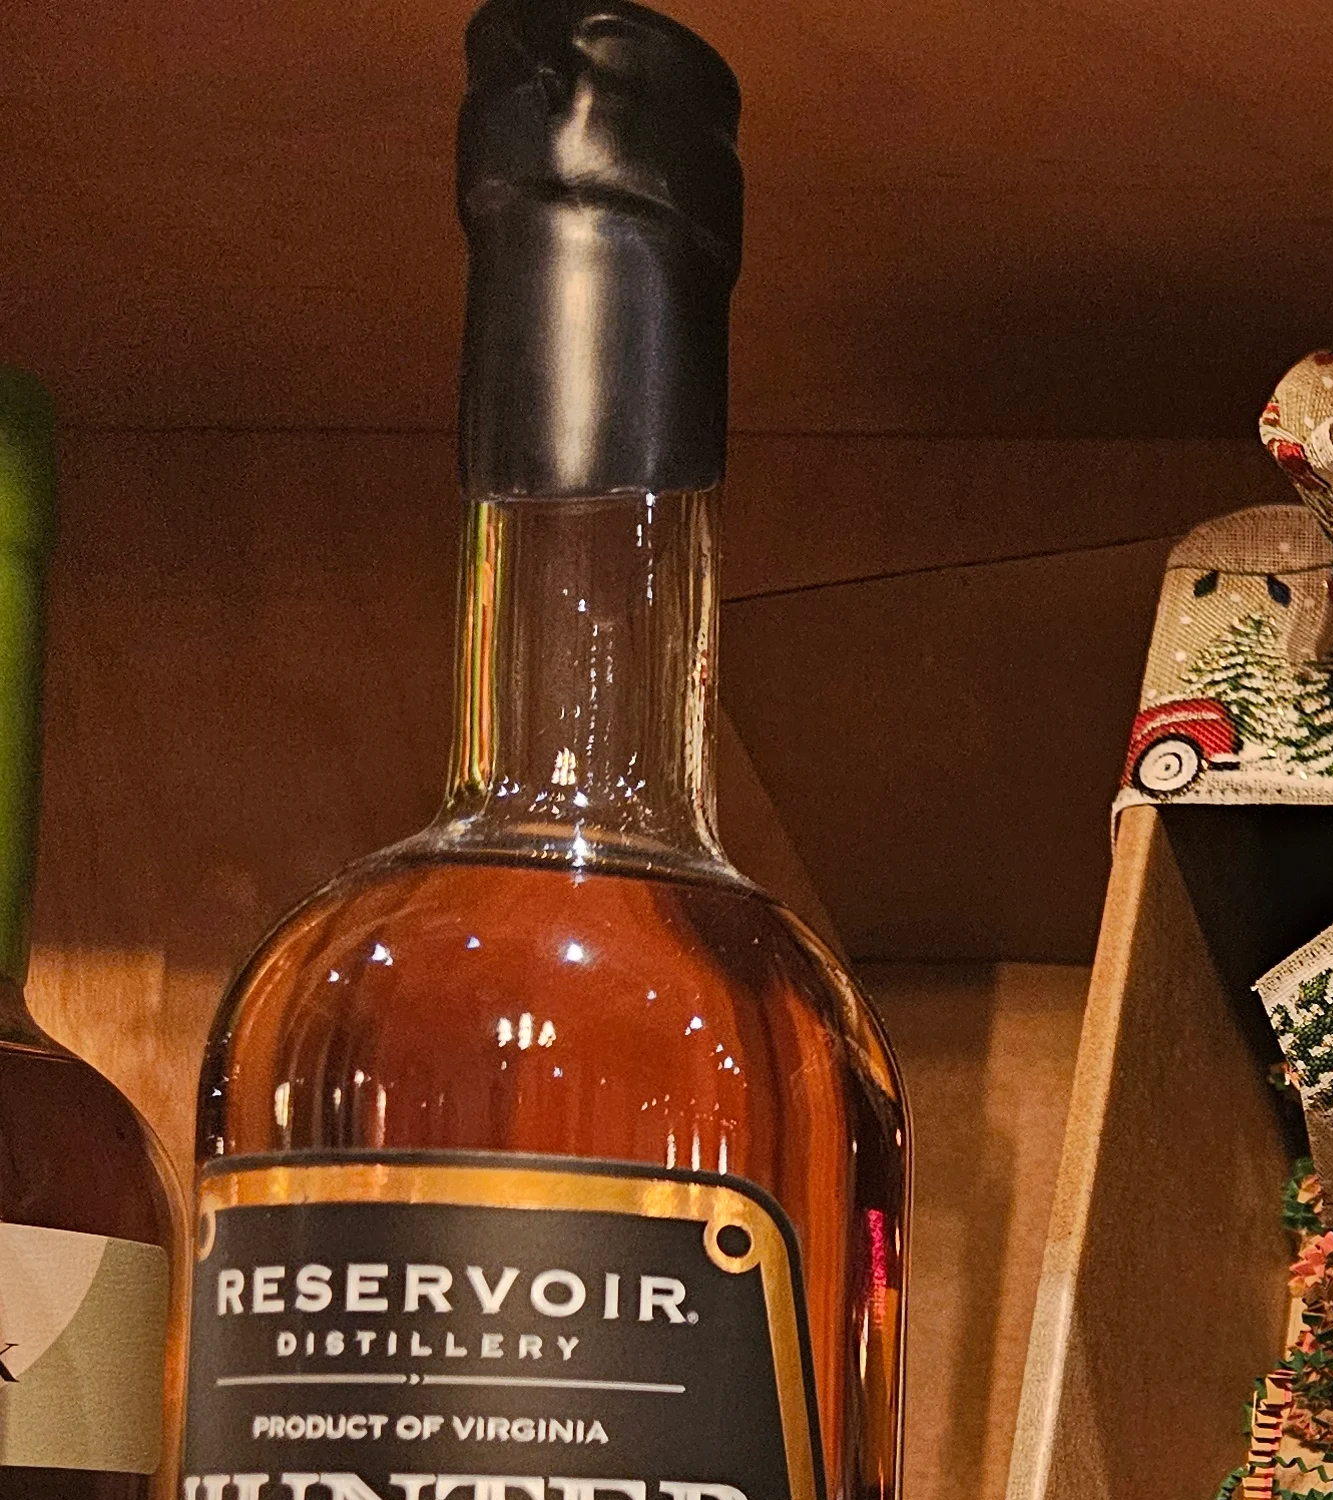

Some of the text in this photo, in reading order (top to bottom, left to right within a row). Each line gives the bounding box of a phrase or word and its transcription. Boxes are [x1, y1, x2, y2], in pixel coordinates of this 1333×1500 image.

[217, 1264, 688, 1325] RESERVOIR
[277, 1331, 582, 1361] DISTILLERY
[252, 1415, 610, 1445] PRODUCT OF VIRGINIA
